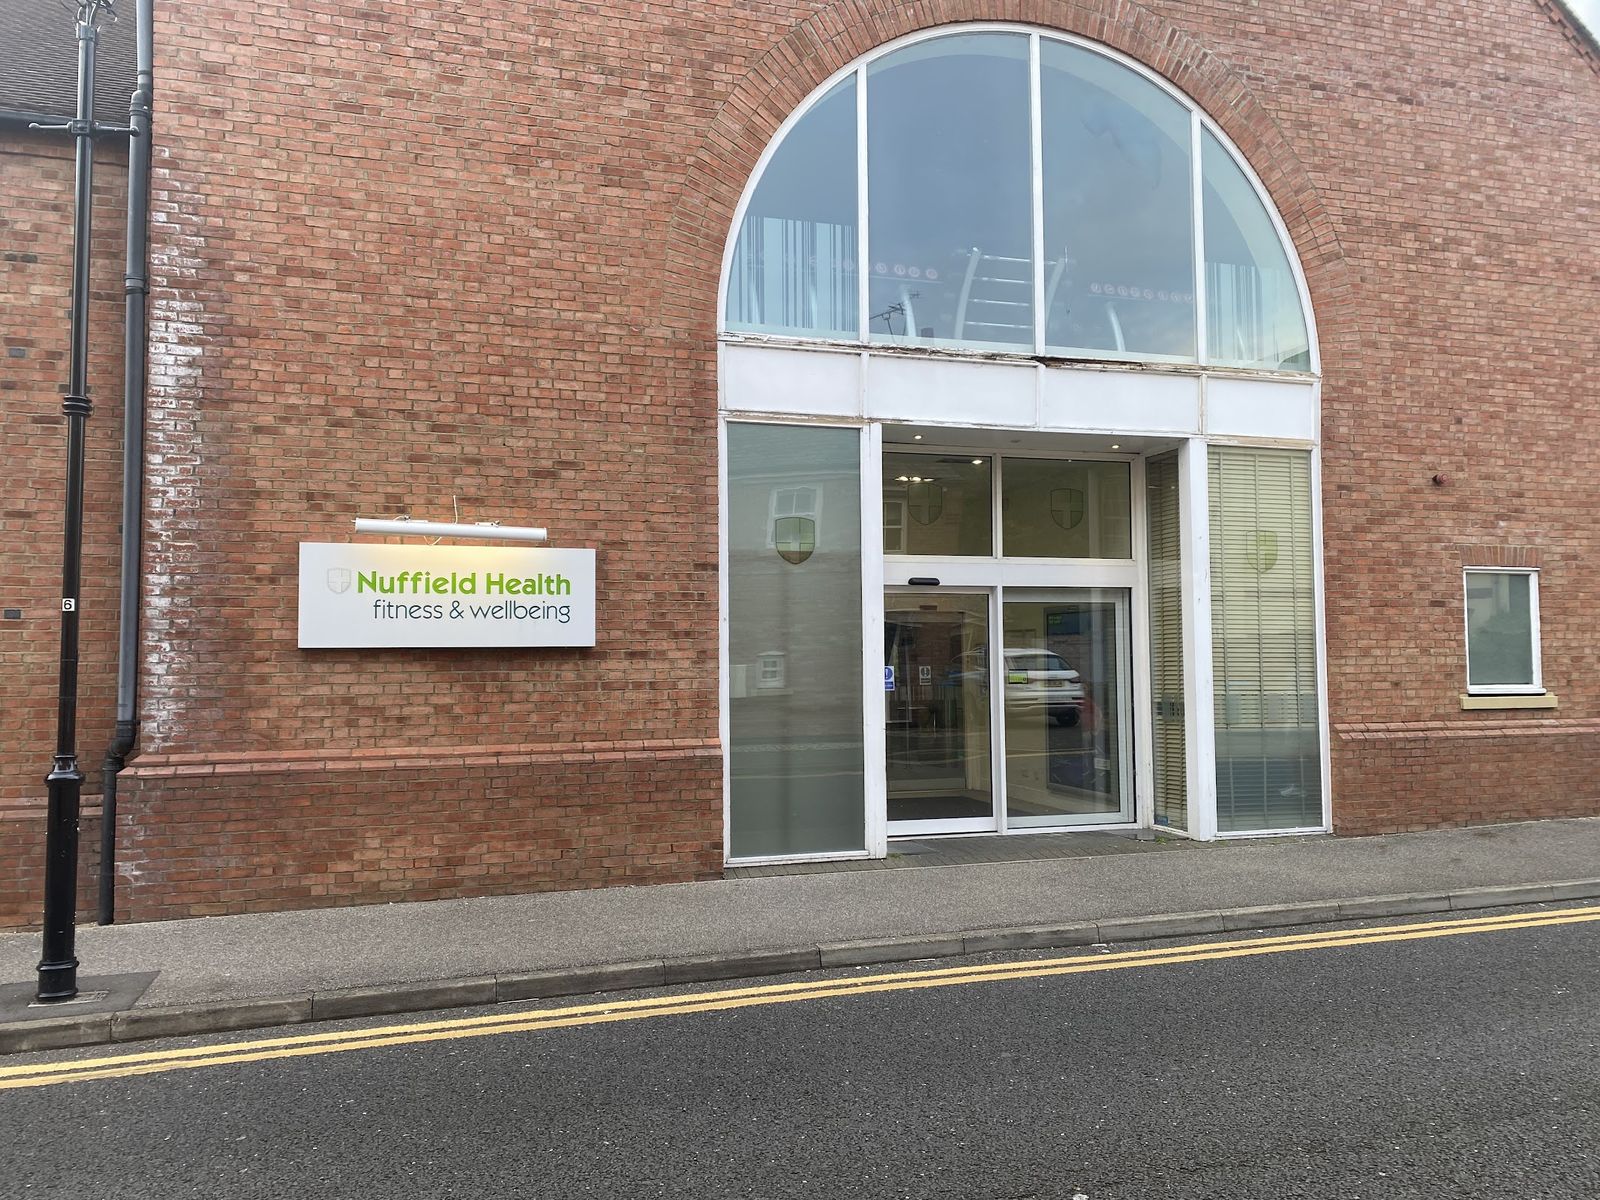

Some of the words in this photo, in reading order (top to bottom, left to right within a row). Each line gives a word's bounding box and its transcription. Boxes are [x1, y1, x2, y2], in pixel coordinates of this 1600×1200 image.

[357, 570, 476, 594] Nuffield
[486, 573, 571, 595] Health
[63, 599, 72, 610] 6
[373, 599, 443, 619] fitness
[449, 600, 465, 620] &
[470, 600, 571, 624] wellbeing
